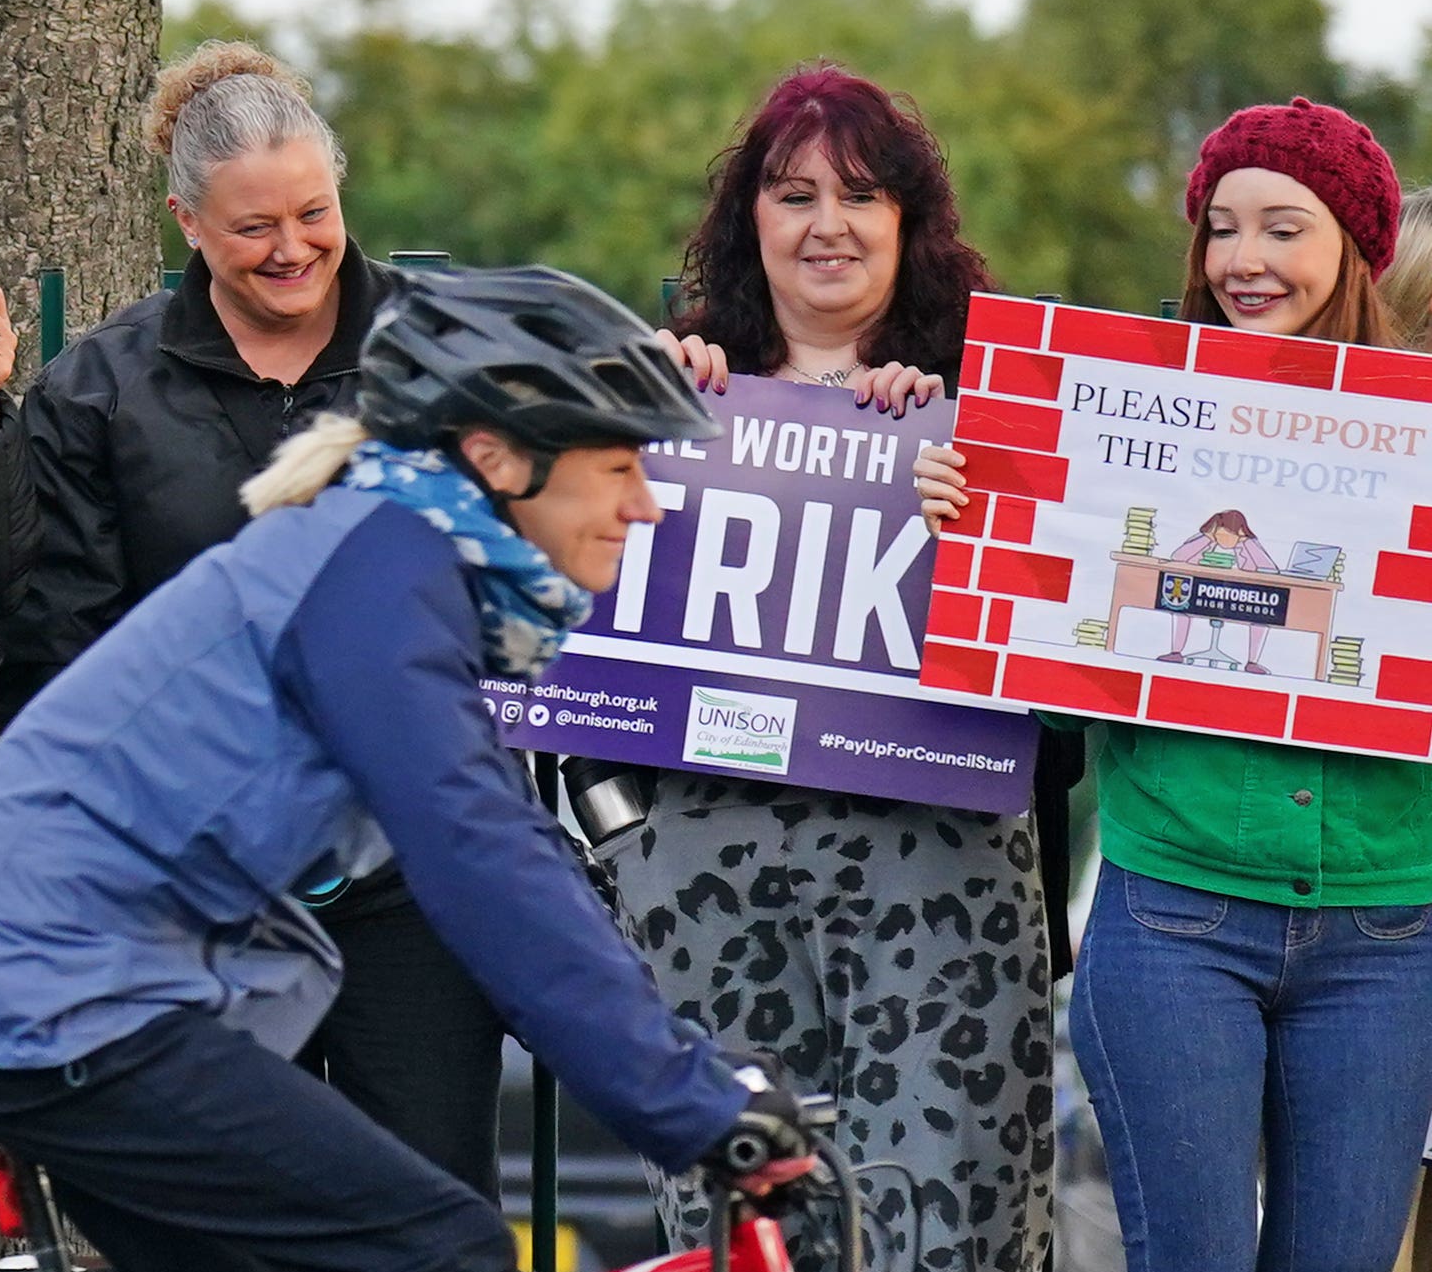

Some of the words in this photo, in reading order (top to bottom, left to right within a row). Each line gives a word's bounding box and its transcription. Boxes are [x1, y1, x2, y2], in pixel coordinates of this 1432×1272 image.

[1072, 383, 1216, 430] PLEASE
[1230, 406, 1425, 456] SUPPORT
[732, 416, 898, 483] WORTH
[1098, 434, 1178, 473] THE
[1192, 448, 1387, 499] SUPPORT
[612, 479, 931, 670] TRIK
[1196, 584, 1279, 609] PORTOBELLO
[1196, 599, 1223, 609] HIGH
[1231, 603, 1274, 616] SCHOOL
[479, 680, 657, 715] unison-edinburgh.org.uk
[556, 710, 653, 733] @unisonedin
[699, 707, 785, 736] UNISON
[697, 731, 716, 744] City
[720, 735, 734, 746] of
[734, 736, 787, 751] Edinburgh
[819, 733, 1015, 773] #PayUpForCouncilStaff
